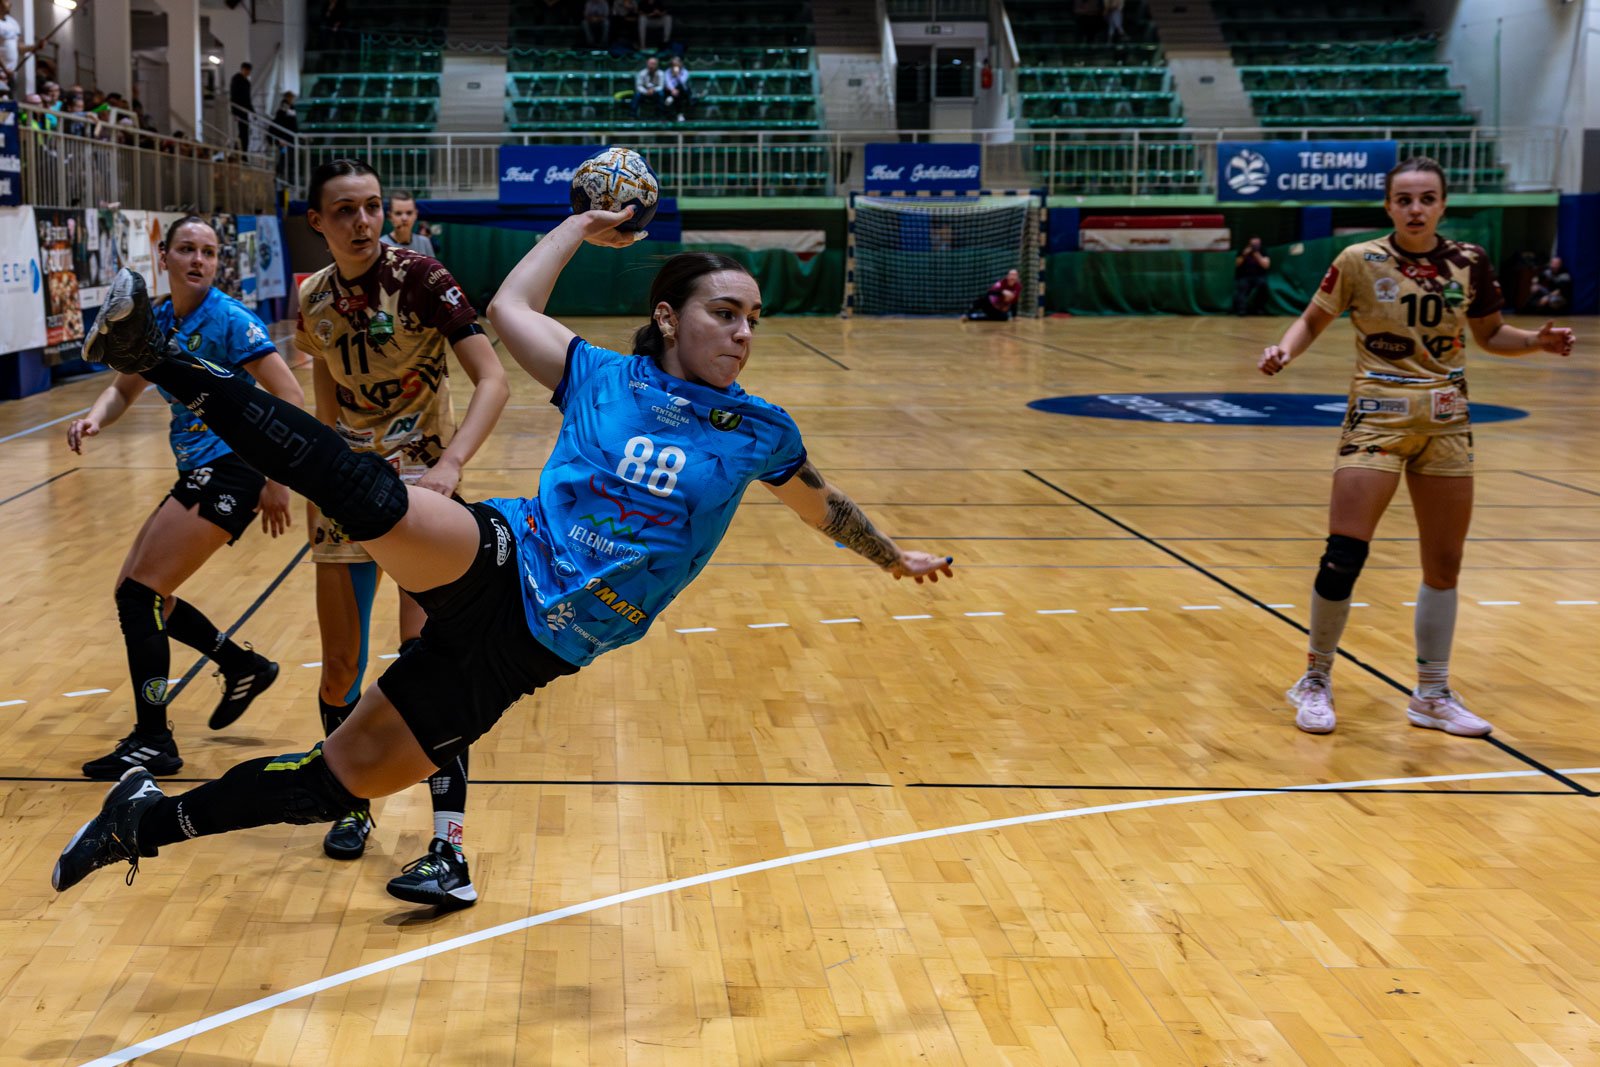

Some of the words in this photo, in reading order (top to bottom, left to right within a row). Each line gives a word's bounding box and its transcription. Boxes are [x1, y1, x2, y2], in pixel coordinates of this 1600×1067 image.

[1298, 151, 1367, 169] TERMY
[1277, 173, 1386, 191] CIEPLICKIE
[1401, 293, 1443, 327] 10
[335, 332, 370, 375] 11
[651, 405, 690, 424] CENTRALNA
[665, 403, 682, 414] LIGA
[656, 414, 681, 428] KOBIET
[616, 435, 686, 498] 88
[567, 524, 615, 556] JELENIA
